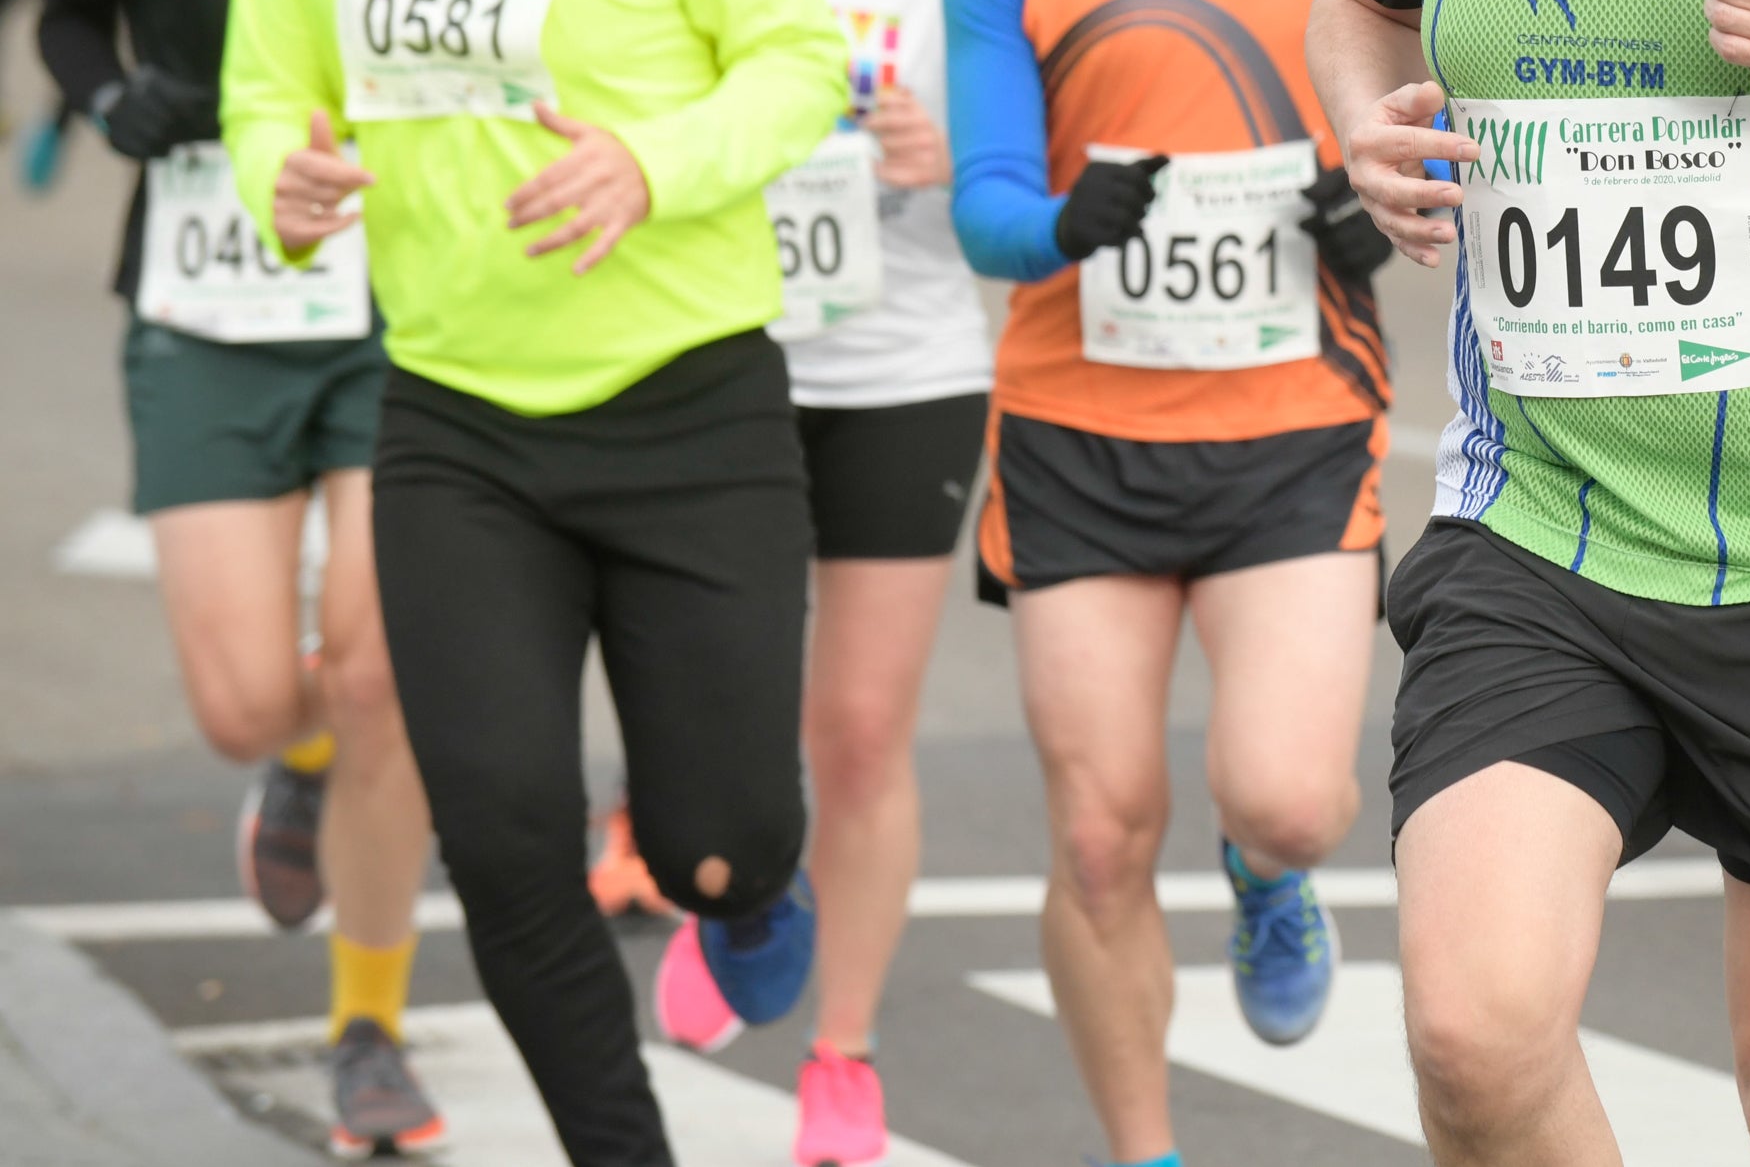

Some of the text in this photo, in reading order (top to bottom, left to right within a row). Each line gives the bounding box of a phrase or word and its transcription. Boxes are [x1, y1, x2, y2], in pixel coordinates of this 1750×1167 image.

[1517, 33, 1663, 52] CENTRO FITNESS
[1515, 56, 1665, 89] GYM-BYM
[1559, 114, 1747, 145] Carrera Popular
[1467, 117, 1548, 186] XXIII
[1583, 176, 1589, 185] 9
[1591, 176, 1602, 185] de
[1603, 176, 1639, 185] febrero
[1640, 175, 1651, 184] de
[1118, 230, 1279, 302] 0561
[1497, 205, 1717, 308] 0149
[1552, 322, 1567, 334] en
[1572, 319, 1583, 334] el
[1588, 319, 1633, 335] barrio,
[1638, 320, 1675, 333] como
[1681, 319, 1697, 330] en
[1681, 354, 1690, 364] El
[1690, 354, 1710, 364] Corte
